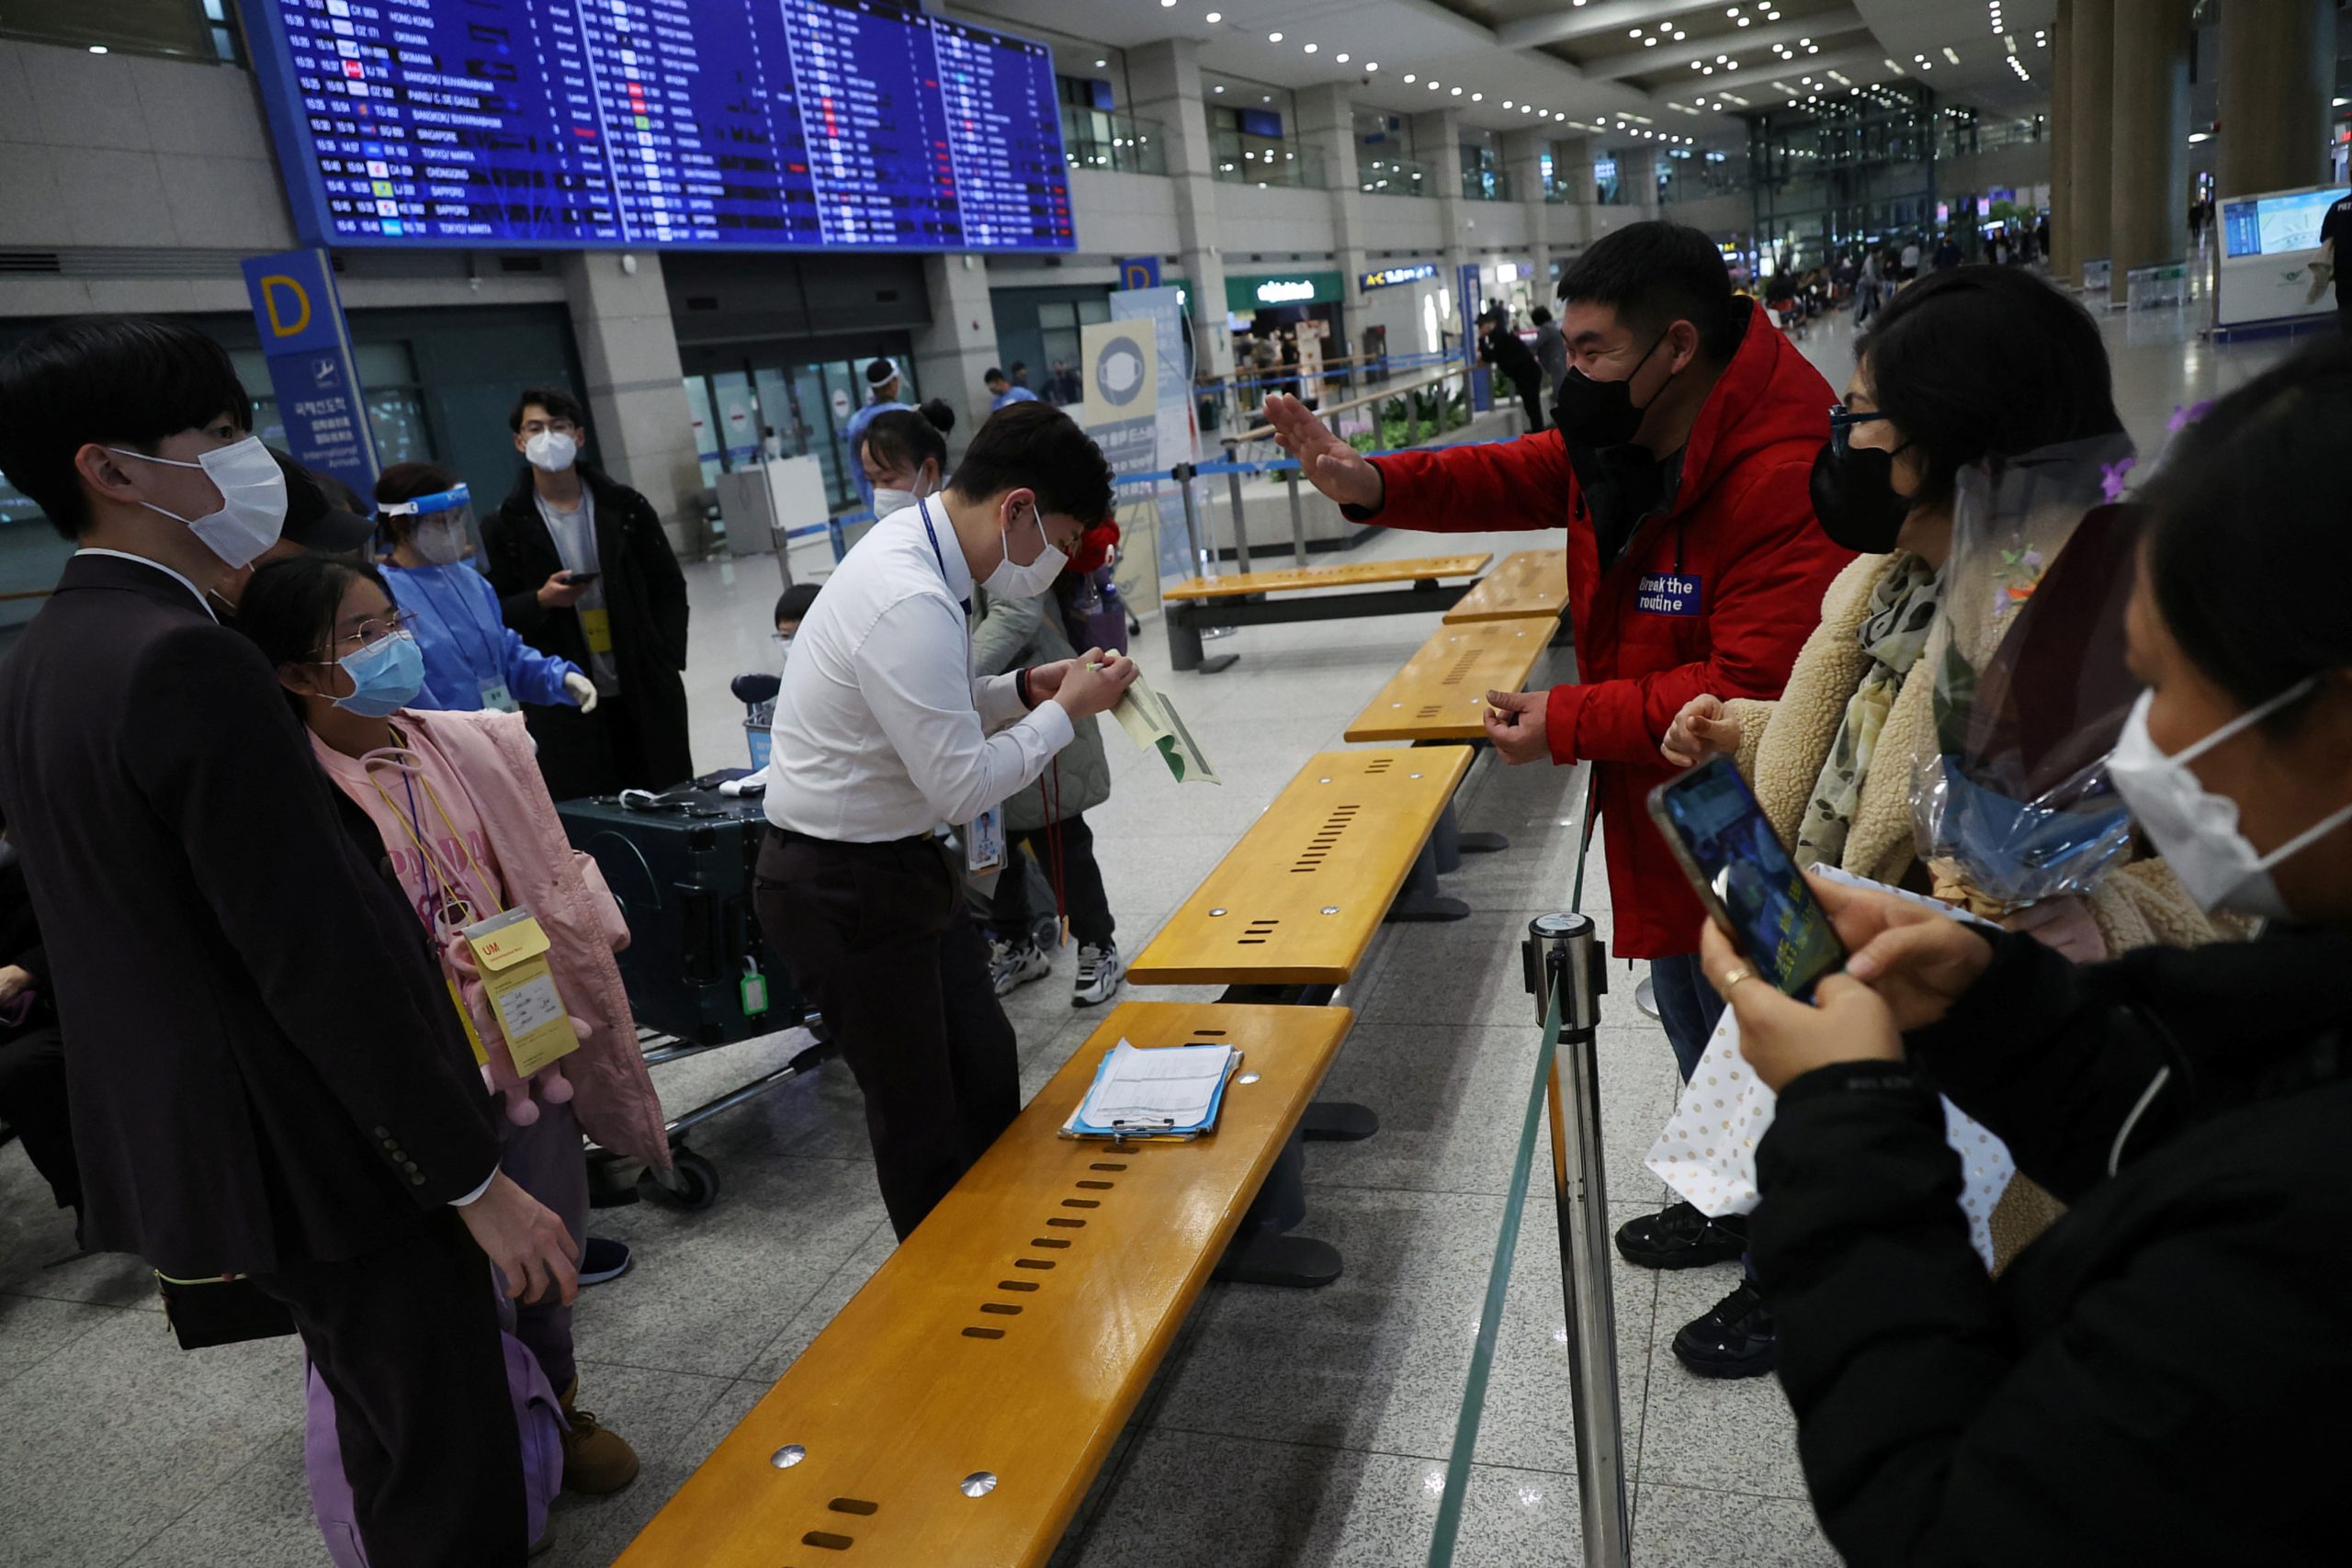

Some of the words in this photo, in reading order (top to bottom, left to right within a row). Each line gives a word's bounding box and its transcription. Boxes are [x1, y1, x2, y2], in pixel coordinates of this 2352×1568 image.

[1126, 265, 1150, 290] D
[260, 275, 311, 338] D
[1639, 577, 1666, 592] Break
[1667, 577, 1693, 594] the
[1640, 594, 1682, 612] routine
[482, 942, 501, 955] UM
